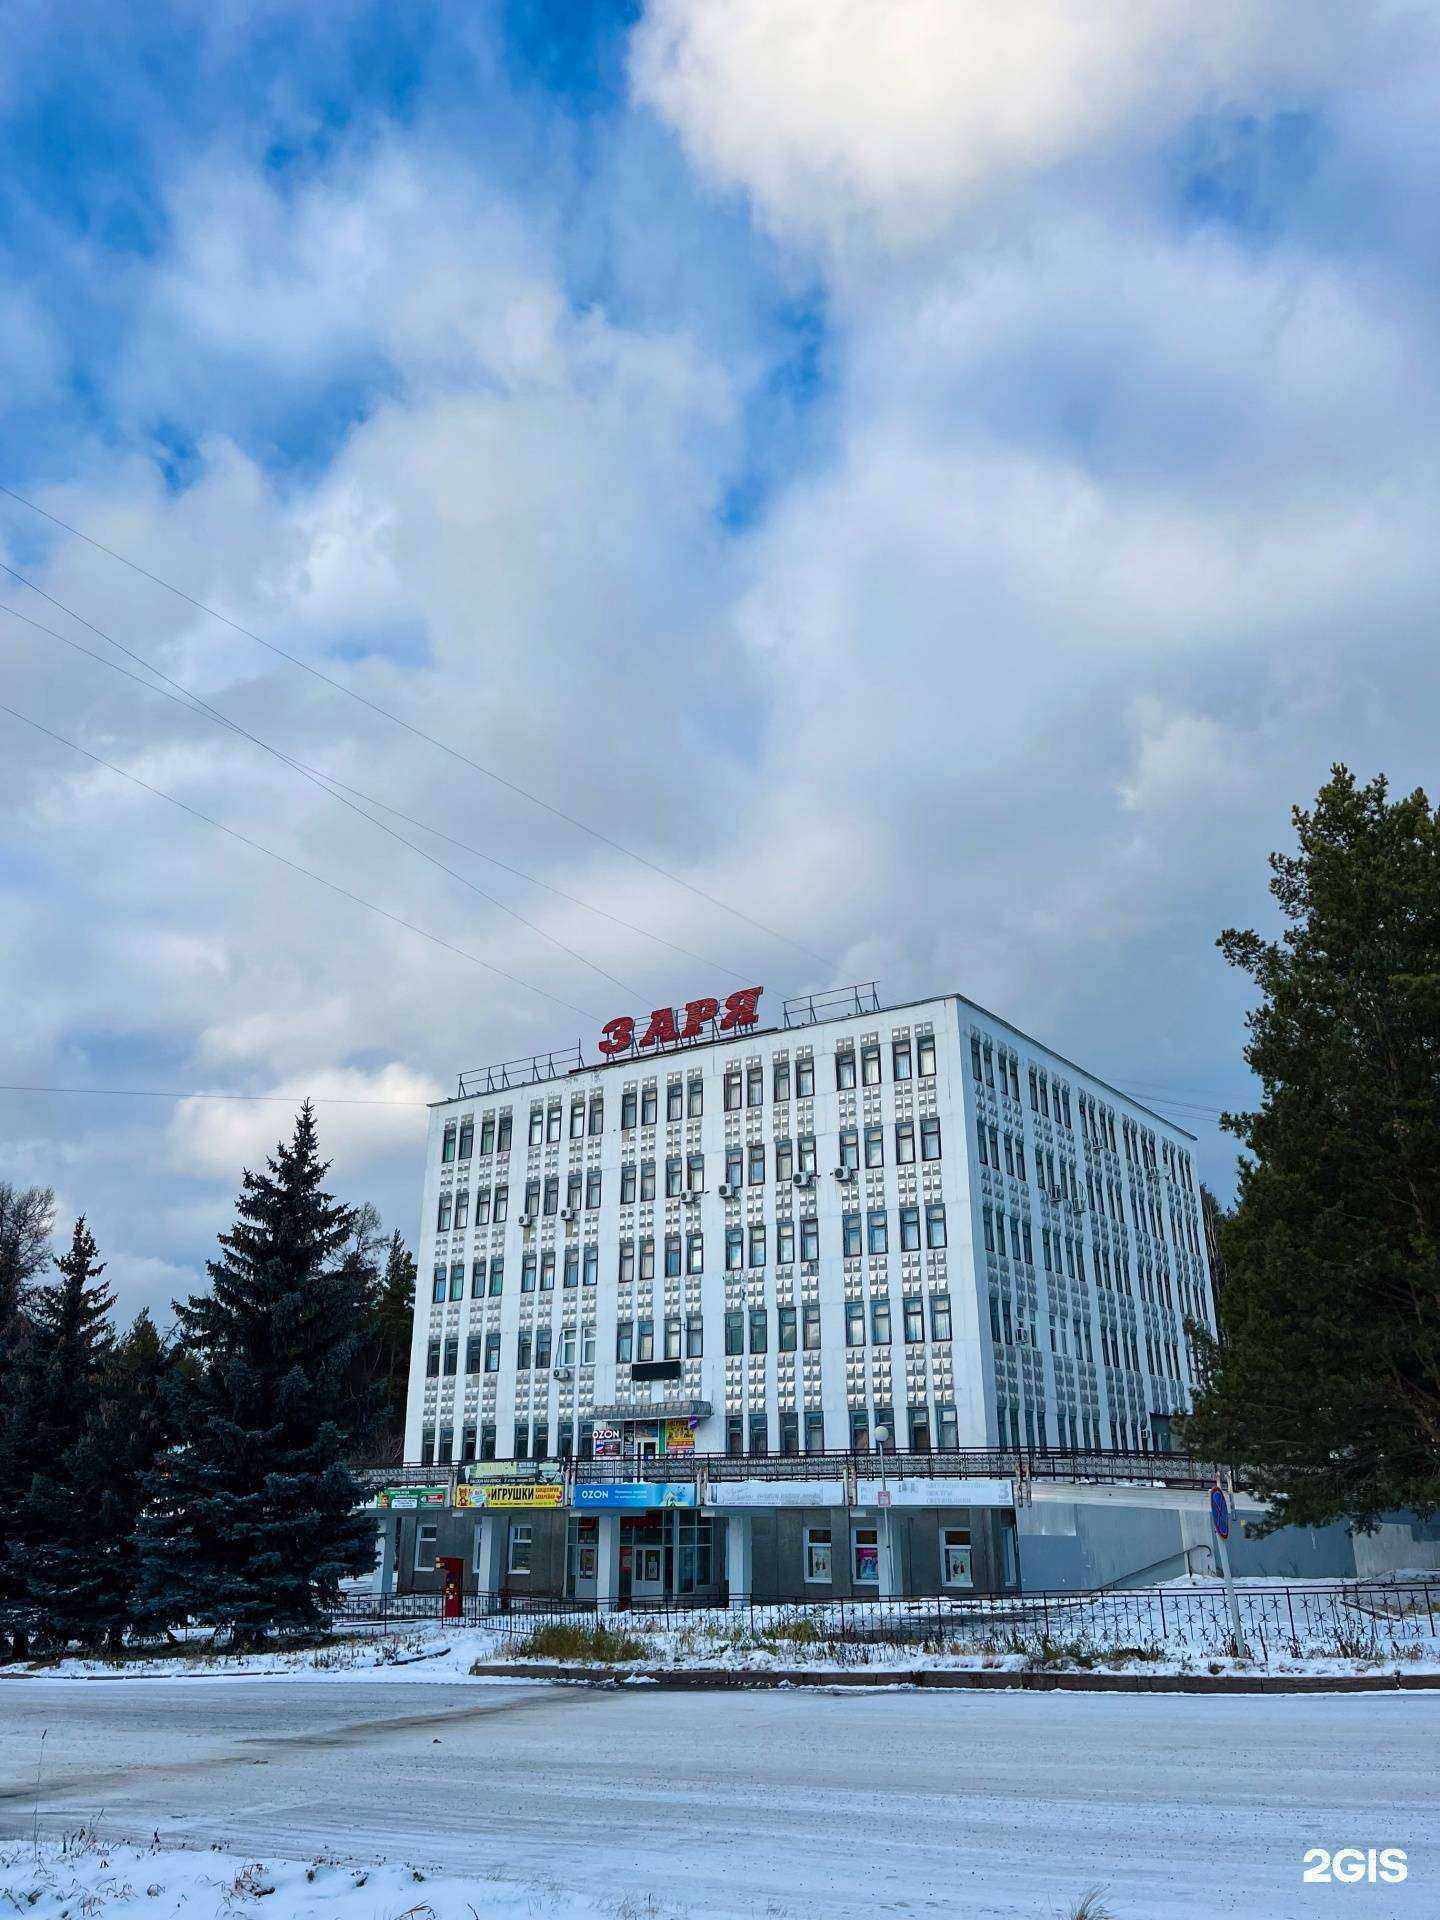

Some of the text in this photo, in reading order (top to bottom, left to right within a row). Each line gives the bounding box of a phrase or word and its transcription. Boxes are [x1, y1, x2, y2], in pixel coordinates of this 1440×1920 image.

[598, 986, 764, 1054] ЗАРЯ
[592, 1430, 620, 1439] OZON
[491, 1487, 534, 1501] ИГРУШКИ
[581, 1490, 609, 1499] OZON
